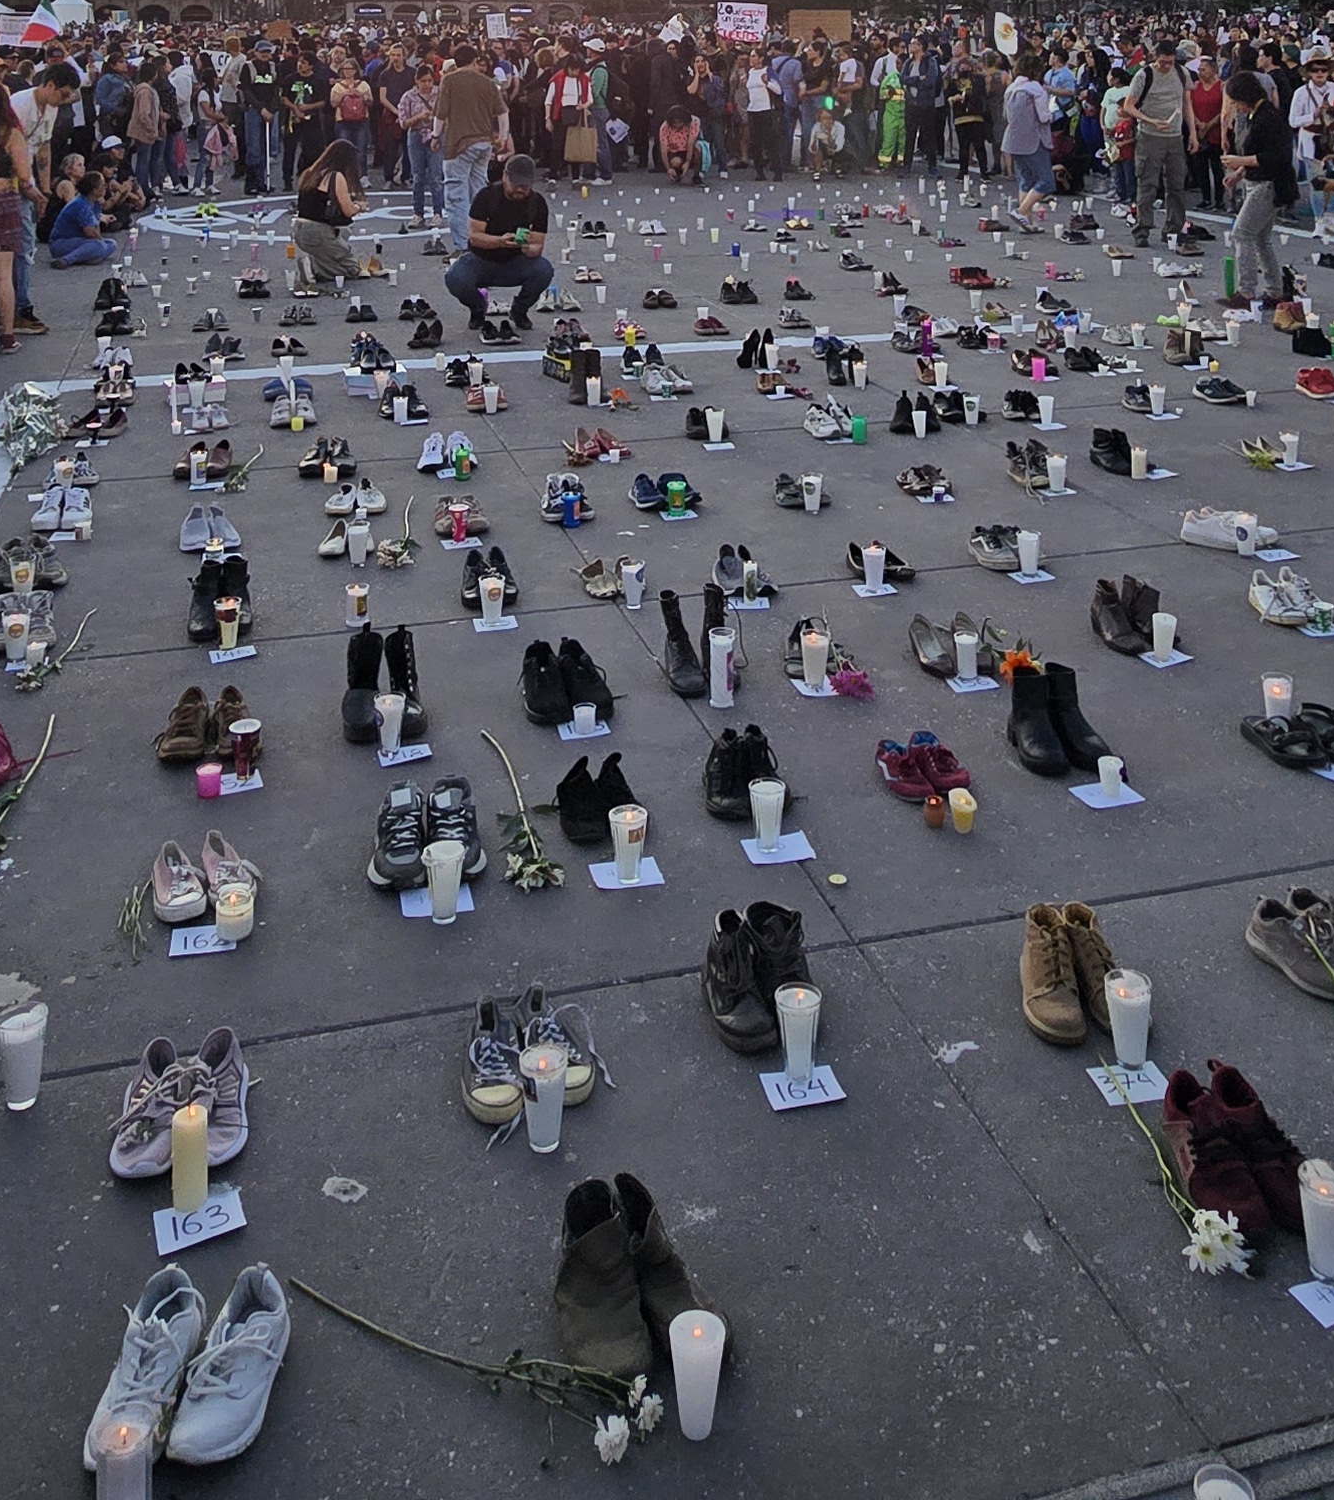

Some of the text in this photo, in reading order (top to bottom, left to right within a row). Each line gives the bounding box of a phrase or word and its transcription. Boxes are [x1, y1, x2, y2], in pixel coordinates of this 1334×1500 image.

[183, 932, 231, 950] 162
[774, 1078, 830, 1103] 164
[1097, 1072, 1158, 1094] 374
[171, 1204, 231, 1242] 163
